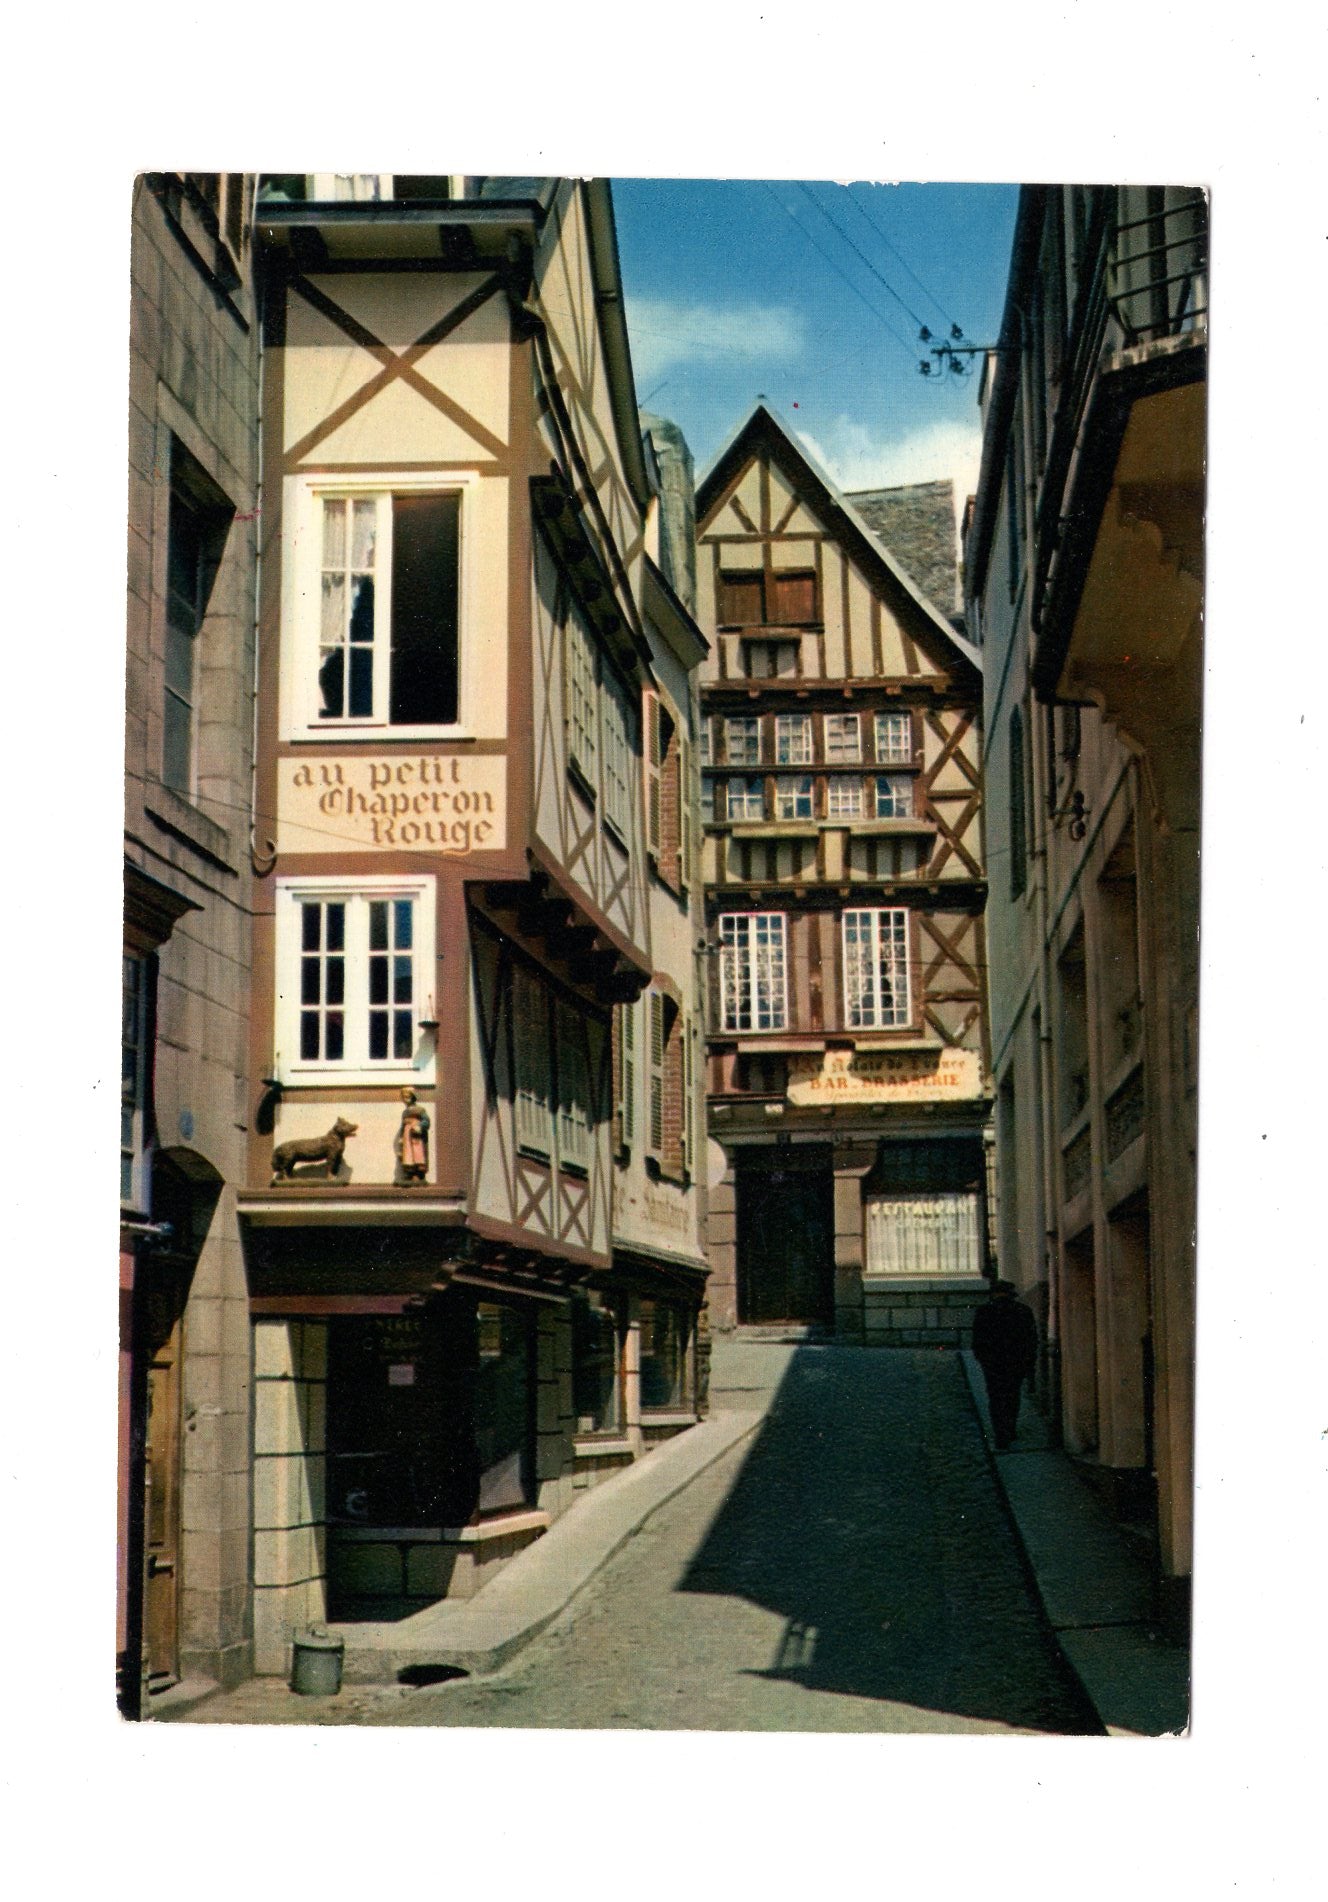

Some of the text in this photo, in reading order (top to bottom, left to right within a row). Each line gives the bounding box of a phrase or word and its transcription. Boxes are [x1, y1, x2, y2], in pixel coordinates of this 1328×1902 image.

[293, 757, 460, 790] au petit
[319, 787, 493, 818] Chaperon
[371, 816, 493, 856] Rouge
[810, 1077, 848, 1090] BAR
[862, 1073, 961, 1089] BRASSERIE
